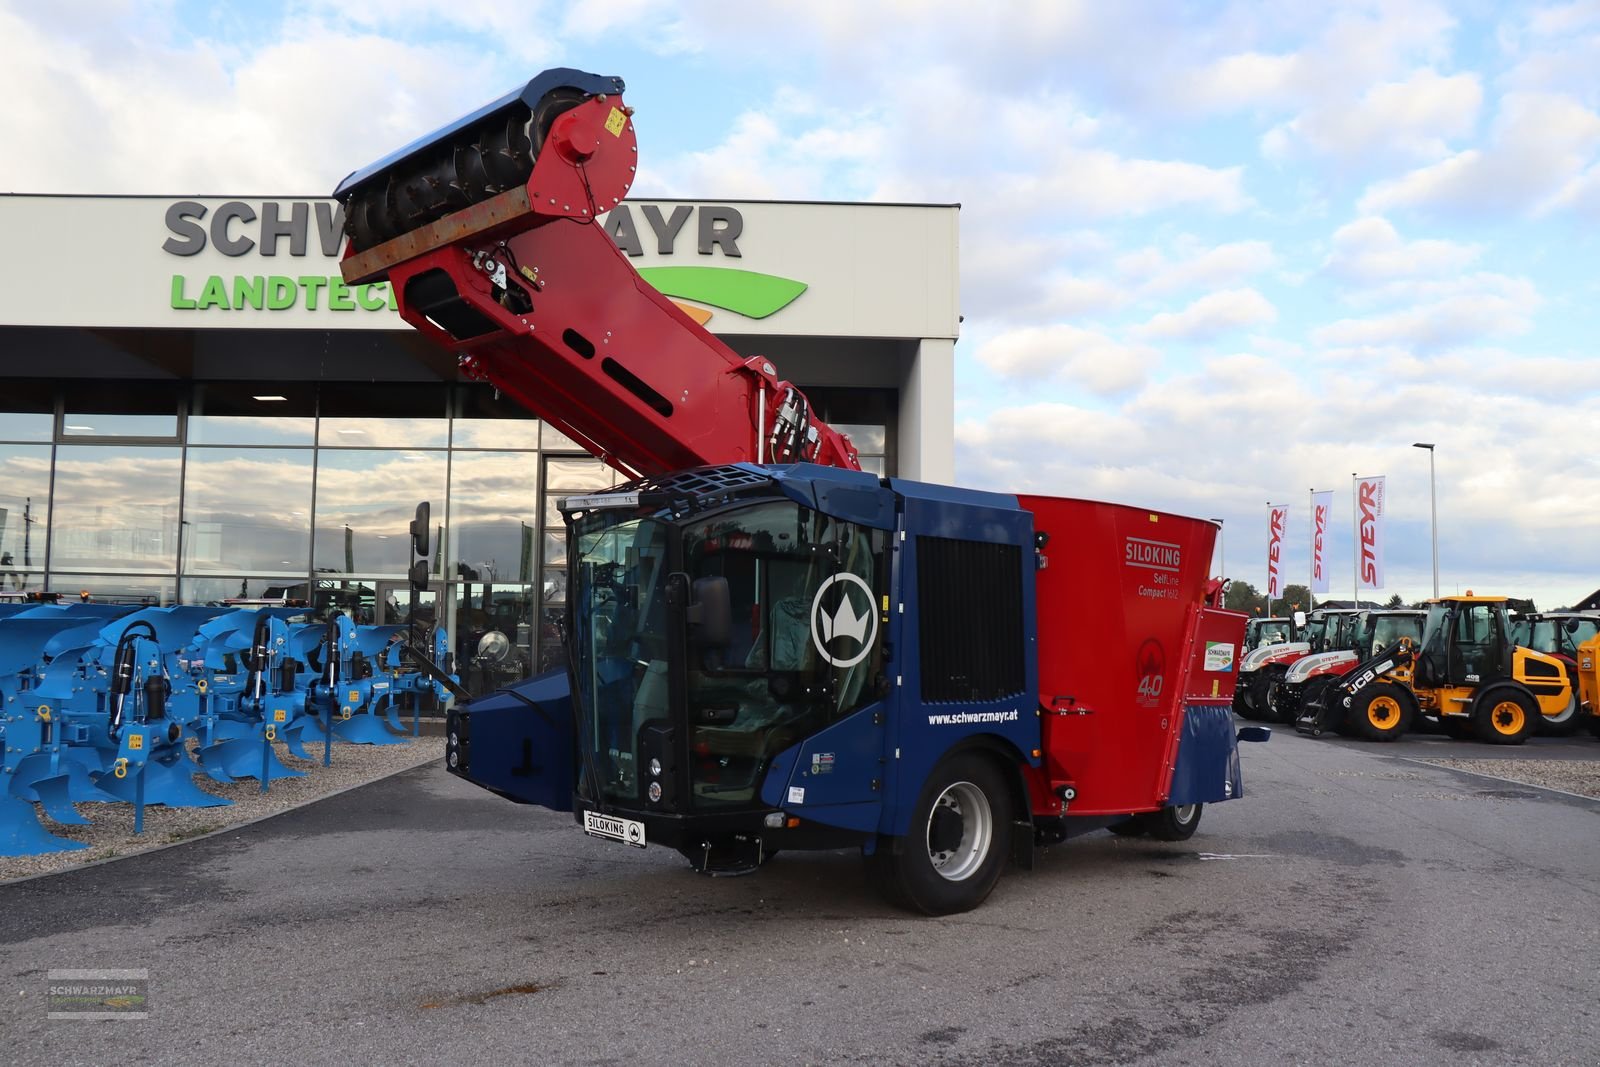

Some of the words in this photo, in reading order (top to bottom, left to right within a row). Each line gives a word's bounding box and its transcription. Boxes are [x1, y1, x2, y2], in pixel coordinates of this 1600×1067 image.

[170, 275, 399, 312] LANDTEC
[1314, 505, 1325, 581] STEYR
[1359, 481, 1377, 587] STEYR
[1126, 543, 1180, 566] SILOKING
[1268, 508, 1283, 597] STEYR
[1138, 585, 1167, 599] Compact
[1350, 670, 1375, 695] JCB
[928, 709, 1018, 725] www.schwarzmayr.at
[588, 817, 625, 834] SILOKING
